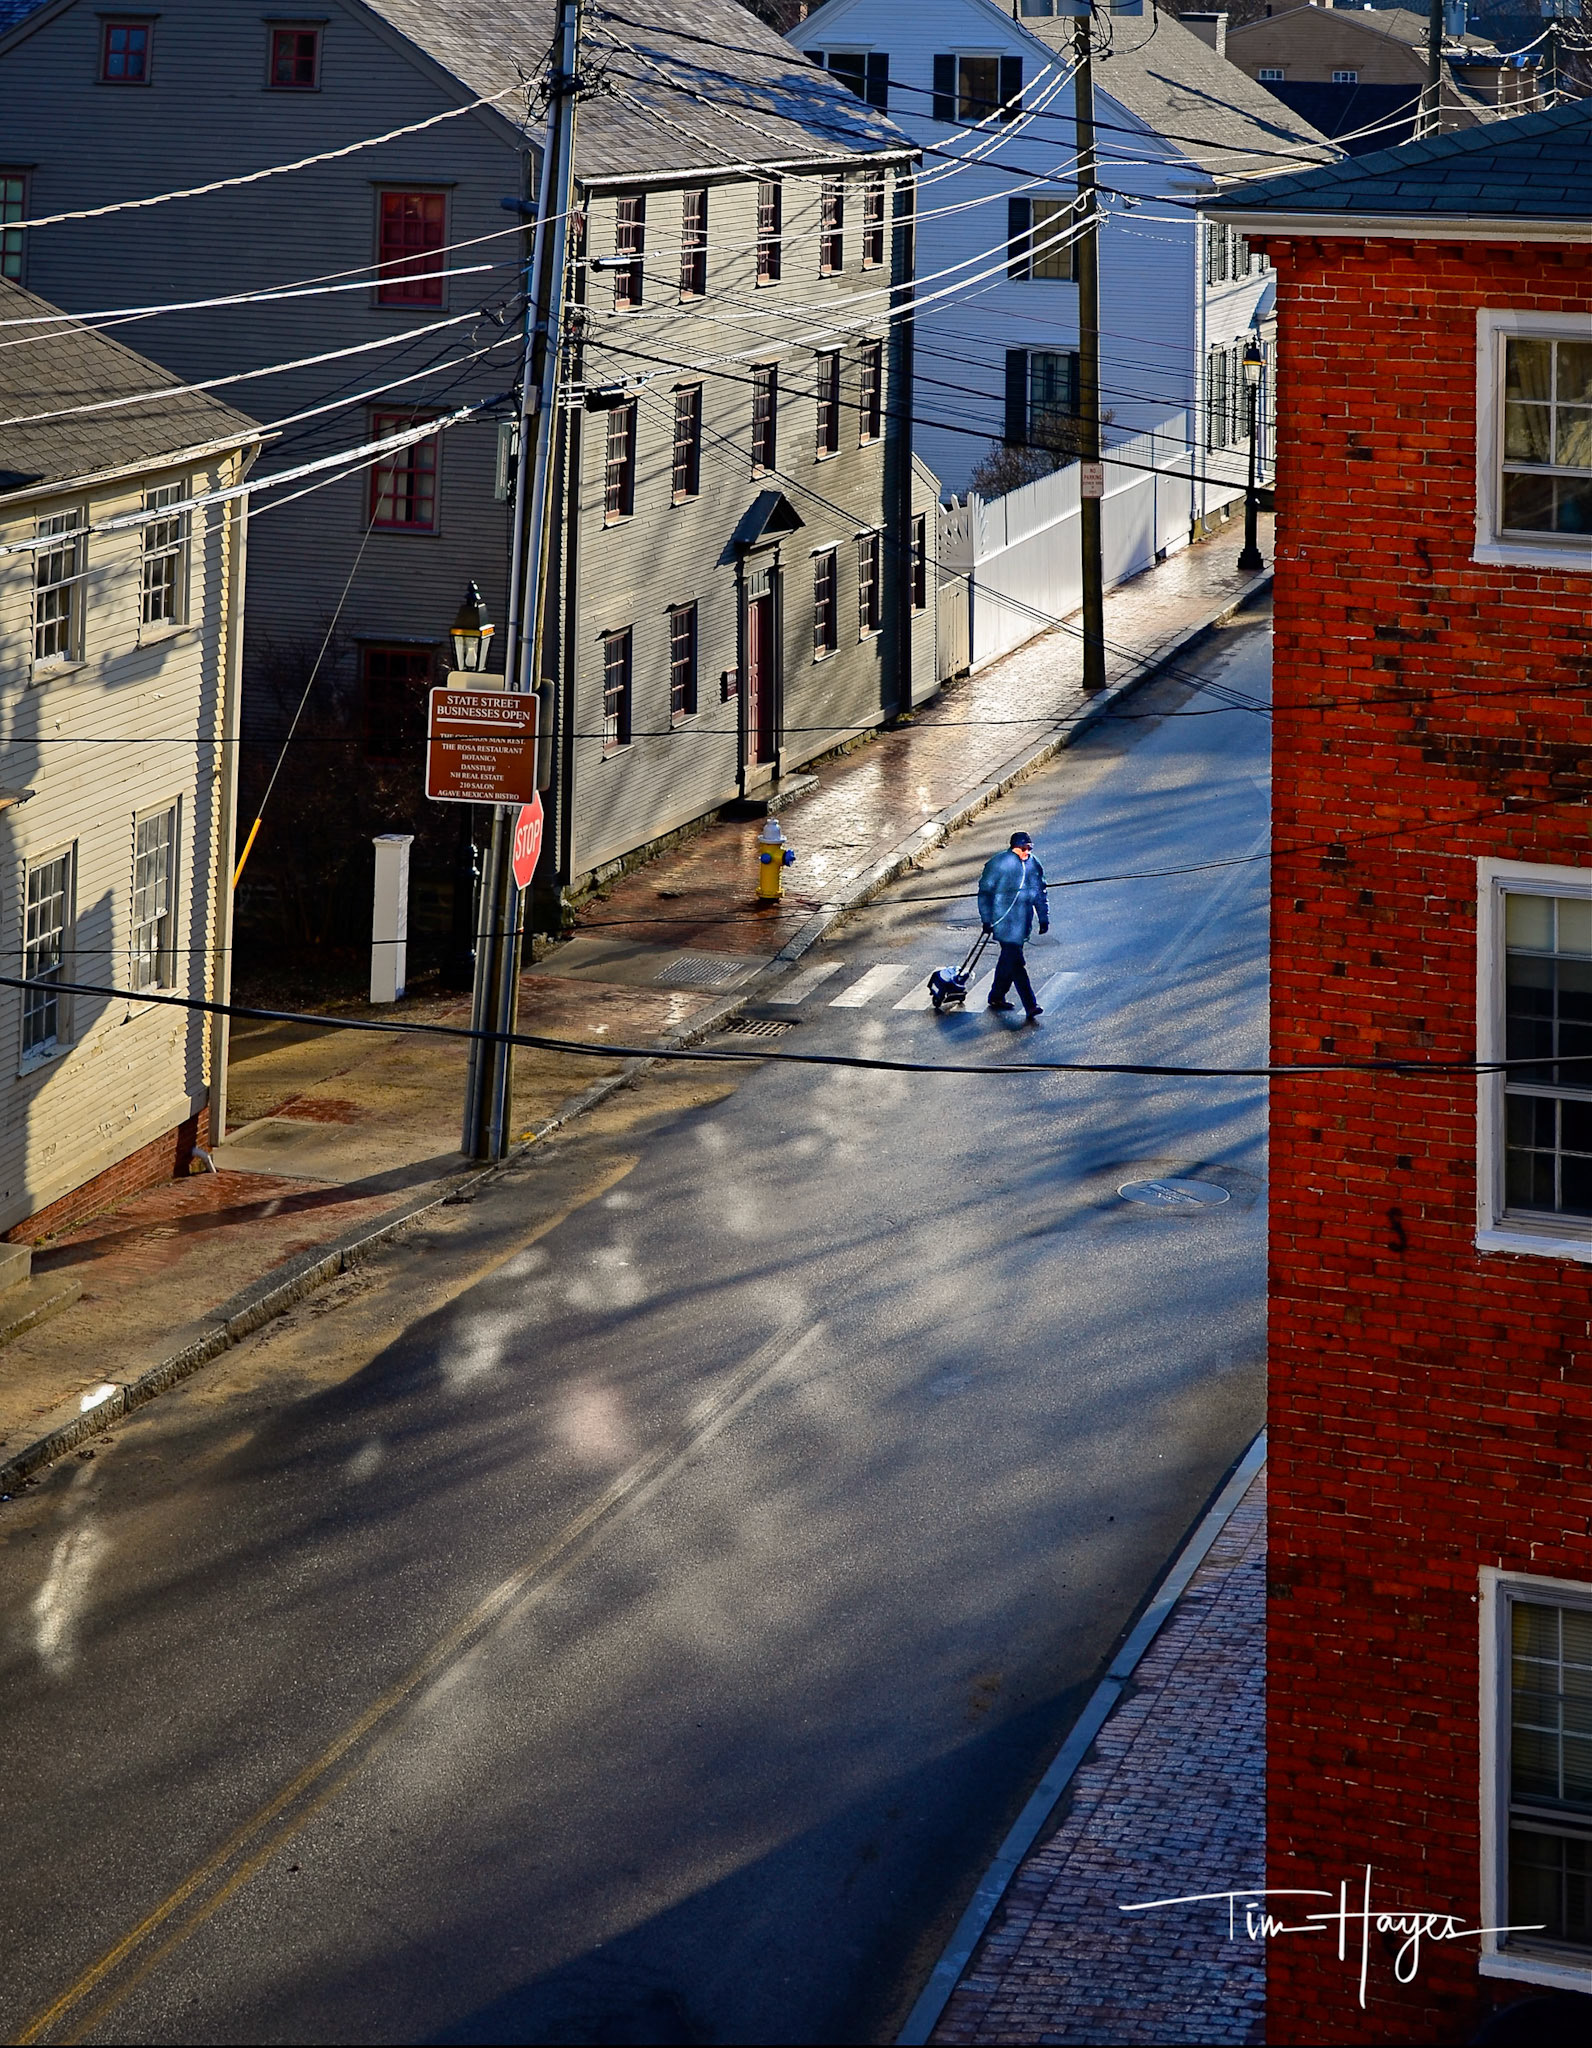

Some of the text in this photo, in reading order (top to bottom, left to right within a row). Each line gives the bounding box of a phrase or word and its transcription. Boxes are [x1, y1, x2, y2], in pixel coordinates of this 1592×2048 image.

[447, 695, 520, 708] STATE STREET
[436, 706, 531, 720] BUSINESSES OPEN
[442, 743, 524, 754] THE ROSA RESTAURANT
[462, 754, 496, 762] BOTANICA
[460, 764, 496, 772] DANSTUFF
[450, 771, 461, 779] NH
[471, 782, 495, 790] SALON
[437, 789, 520, 800] AGAVE MEXICAN BISTRO
[515, 818, 541, 861] STOP
